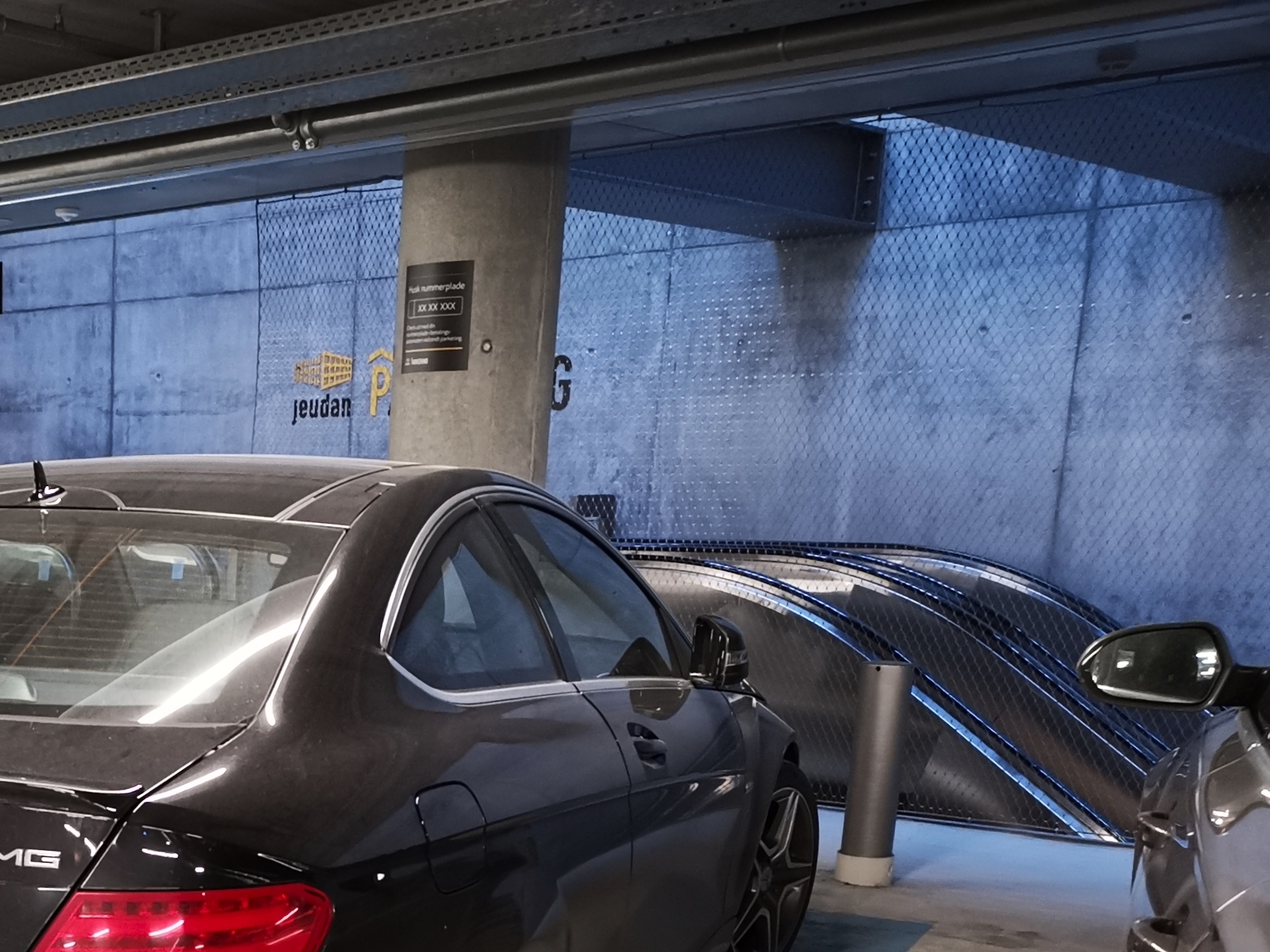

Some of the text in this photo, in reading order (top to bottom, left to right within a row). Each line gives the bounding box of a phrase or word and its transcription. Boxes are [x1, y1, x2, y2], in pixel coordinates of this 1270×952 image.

[418, 302, 456, 313] XX XX XXX
[292, 393, 351, 425] jeudan
